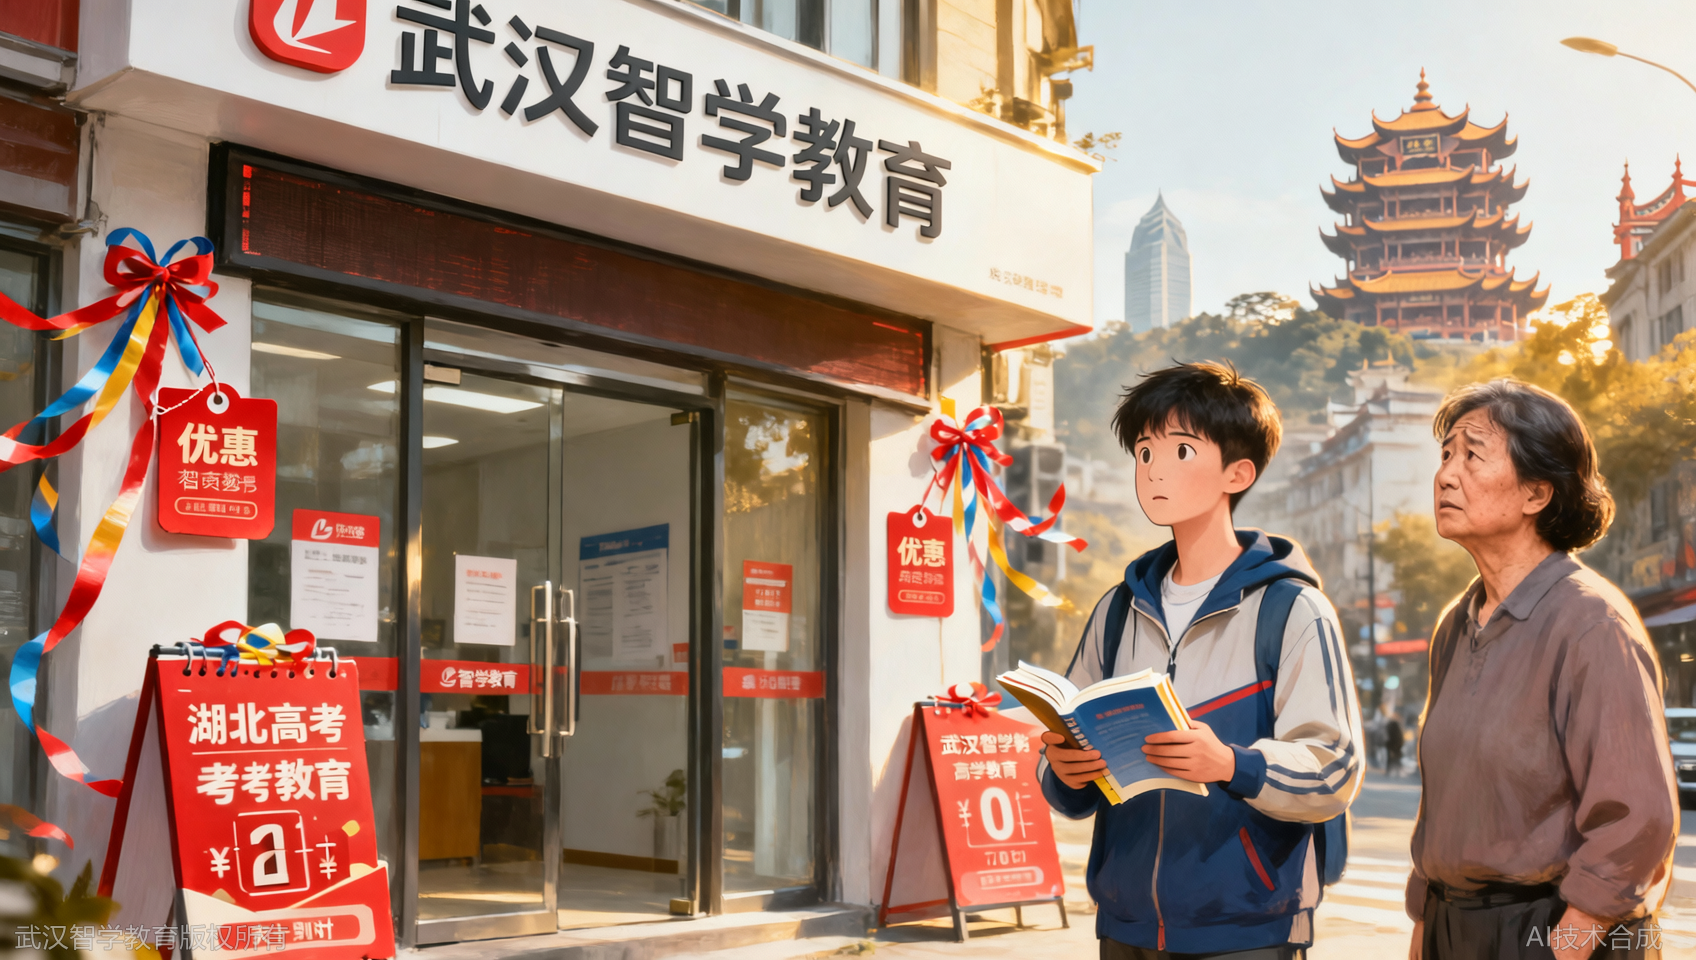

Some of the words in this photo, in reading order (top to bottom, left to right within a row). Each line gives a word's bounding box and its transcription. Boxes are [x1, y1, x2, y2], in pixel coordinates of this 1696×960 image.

[391, 0, 951, 238] 武汉智学教育
[177, 422, 258, 467] 优惠
[897, 536, 946, 567] 优惠
[458, 669, 518, 689] 智学教育
[187, 702, 346, 745] 湖北高考
[196, 758, 351, 805] 考考教育
[980, 787, 1015, 841] 0
